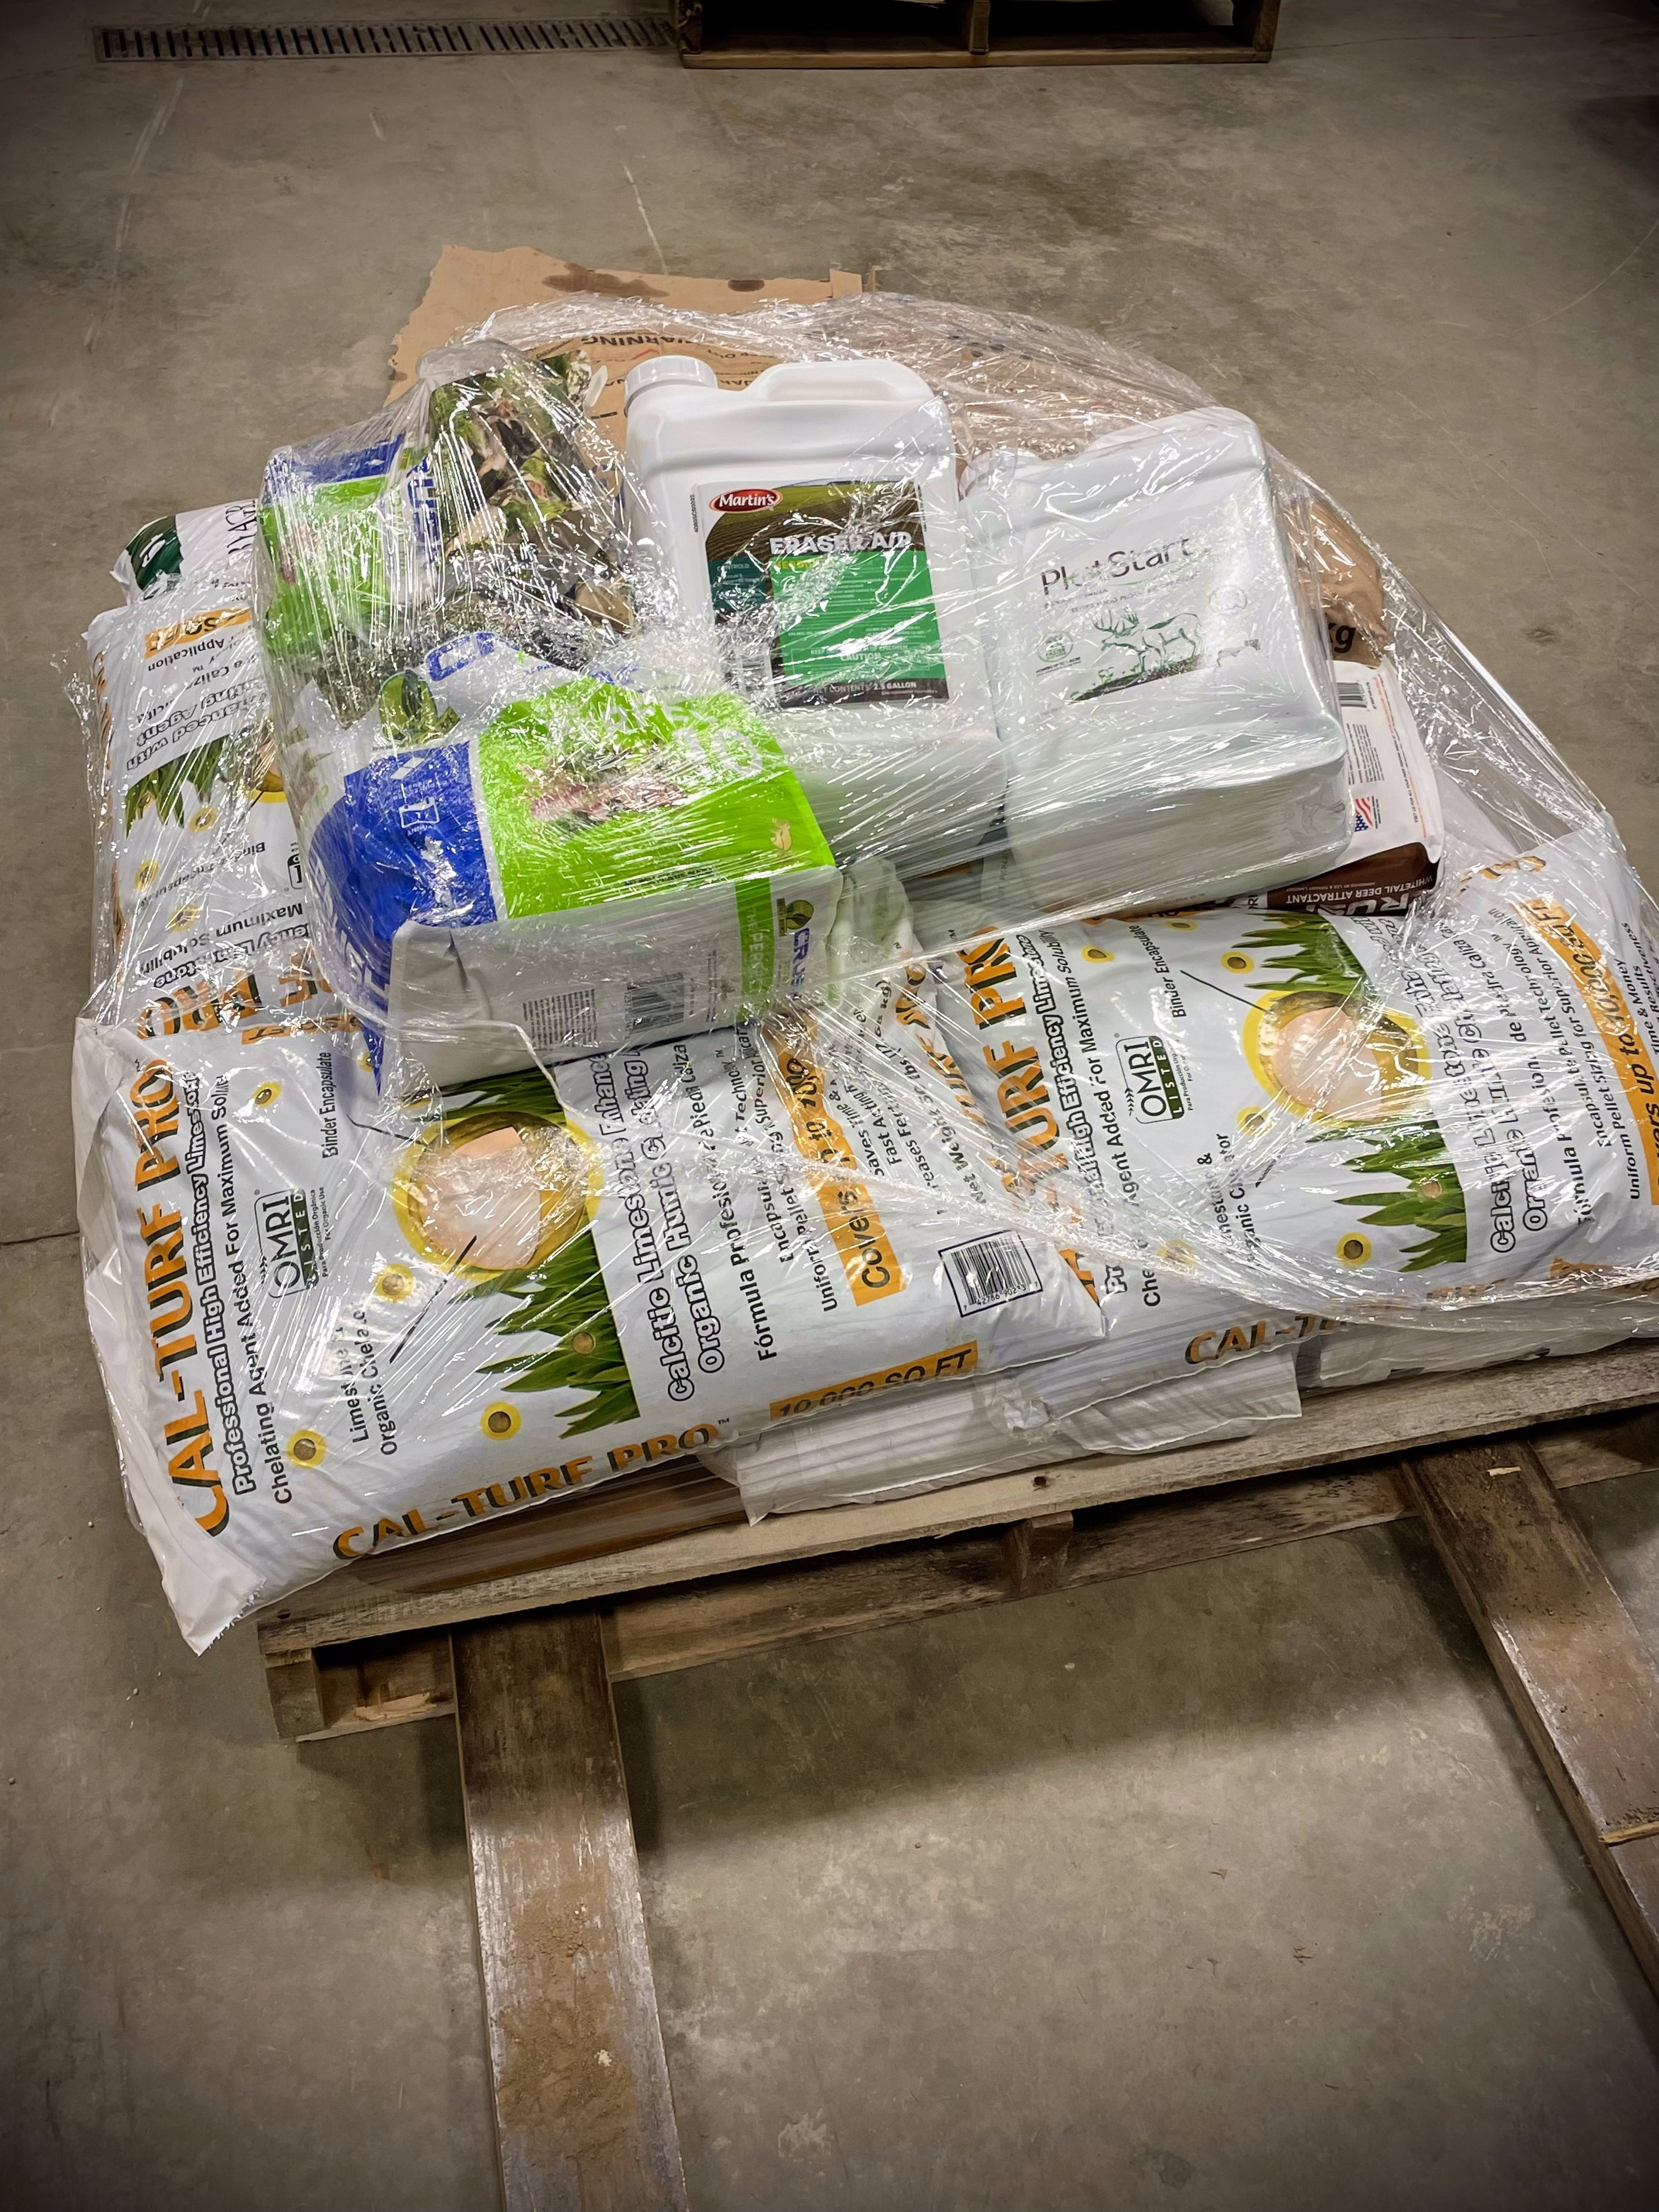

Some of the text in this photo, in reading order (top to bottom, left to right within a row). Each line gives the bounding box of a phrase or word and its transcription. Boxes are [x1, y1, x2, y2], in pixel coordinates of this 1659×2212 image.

[719, 494, 775, 507] Martin's
[148, 639, 224, 671] Application
[840, 652, 881, 662] CAUTION
[127, 737, 168, 771] with
[137, 704, 198, 747] Agent
[1286, 874, 1433, 904] WHITETAIL DEER ATTRACTANT
[216, 902, 303, 938] Maximum
[1128, 924, 1170, 974] Encapsulate
[1016, 934, 1057, 1014] Limestone
[1453, 939, 1486, 968] Caliza
[1614, 958, 1644, 1005] Money
[1067, 977, 1097, 1053] Maximum
[1509, 1022, 1527, 1042] de
[1569, 1017, 1587, 1037] for
[1637, 1008, 1649, 1017] &
[1042, 1014, 1082, 1112] Efficiency
[1088, 1057, 1107, 1087] For
[1619, 1033, 1639, 1056] to
[318, 1052, 339, 1159] Binder Encapsulate
[1124, 1040, 1167, 1116] OMRI
[1153, 1039, 1183, 1114] LISTED
[1631, 1064, 1655, 1094] up
[129, 1059, 183, 1192] PRO
[1094, 1090, 1124, 1147] Added
[1598, 1086, 1625, 1130] Pellet
[217, 1124, 237, 1223] Maximum
[877, 1130, 902, 1166] Fast
[1196, 1152, 1213, 1166] &
[1620, 1134, 1640, 1200] Uniform
[191, 1173, 216, 1286] Efficiency
[224, 1222, 240, 1257] For
[262, 1196, 300, 1290] OMRI
[838, 1191, 890, 1288] Covers
[199, 1284, 227, 1344] High
[229, 1258, 253, 1329] Added
[677, 1254, 725, 1374] Organic
[740, 1269, 778, 1361] Fórmula
[244, 1328, 266, 1398] Agent
[646, 1286, 695, 1402] Calcitic
[934, 1348, 972, 1378] FT
[206, 1343, 257, 1496] Professional
[370, 1383, 398, 1456] Organic
[253, 1403, 292, 1505] Chelating
[332, 1424, 719, 1561] CAL-TURF PRO
